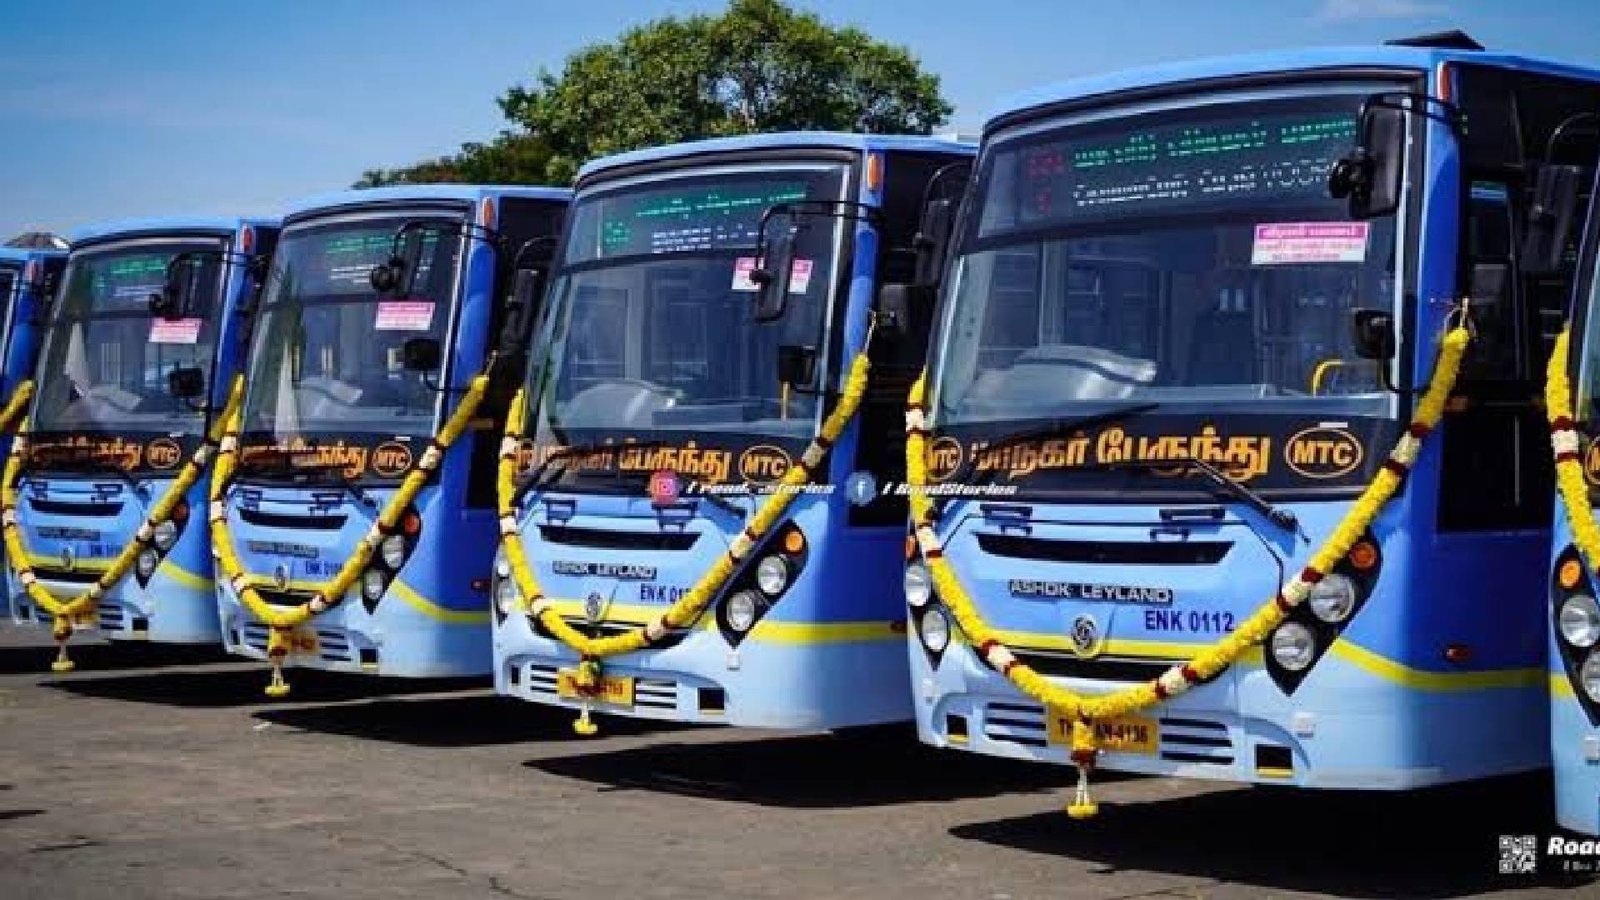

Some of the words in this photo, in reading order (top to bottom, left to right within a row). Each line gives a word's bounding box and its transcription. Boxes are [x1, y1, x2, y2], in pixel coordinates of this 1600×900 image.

[376, 451, 406, 468] MTC
[743, 455, 785, 476] MTC
[1097, 426, 1271, 482] பேருந்து
[1292, 440, 1354, 468] MTC
[640, 583, 667, 602] ENK
[1009, 579, 1071, 598] ASHOK
[1080, 583, 1172, 604] LEYLAND
[1145, 609, 1183, 632] ENK
[1188, 611, 1235, 633] 0112
